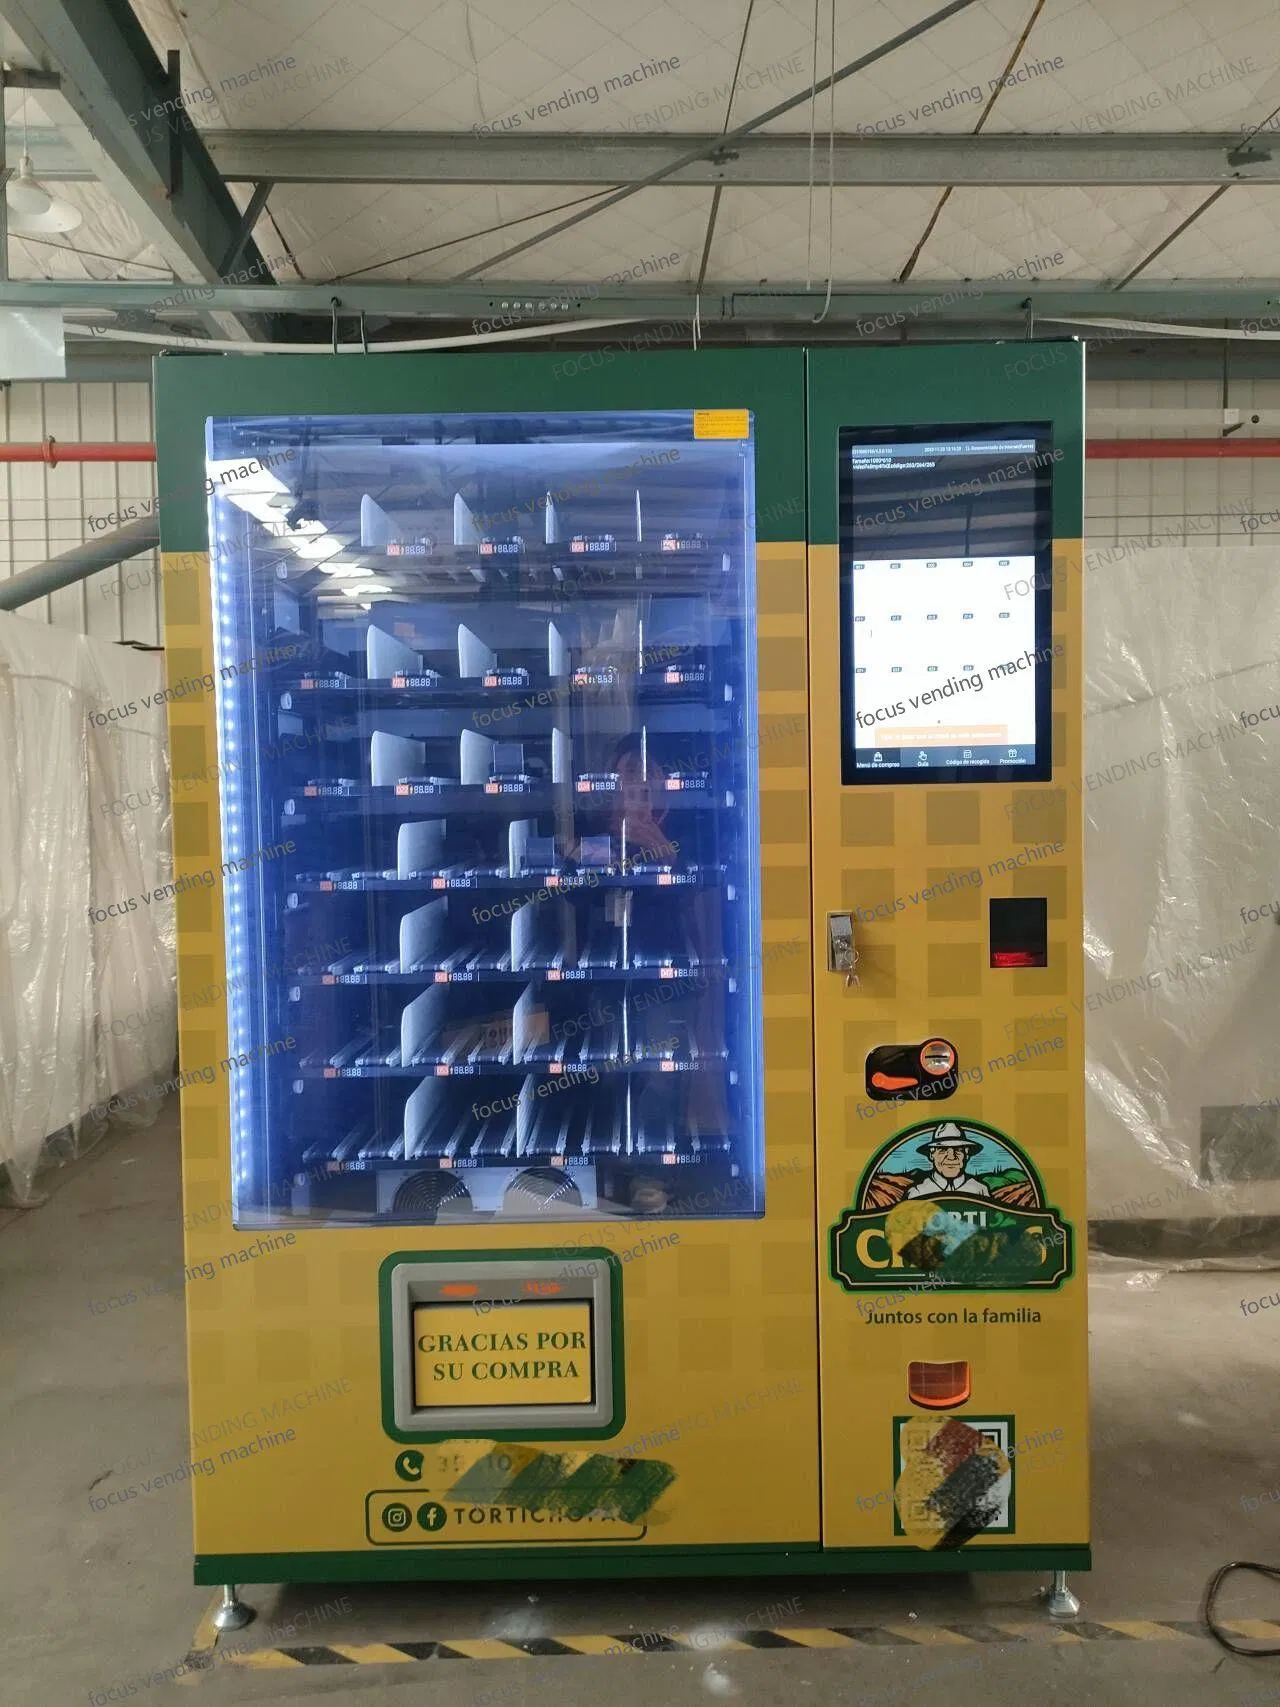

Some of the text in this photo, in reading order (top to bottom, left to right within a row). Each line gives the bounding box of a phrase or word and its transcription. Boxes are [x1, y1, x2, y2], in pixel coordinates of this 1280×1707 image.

[865, 1307, 1041, 1325] Juntos con la familia
[418, 1331, 587, 1353] GRACIAS POR
[433, 1360, 580, 1381] SU COMPRA
